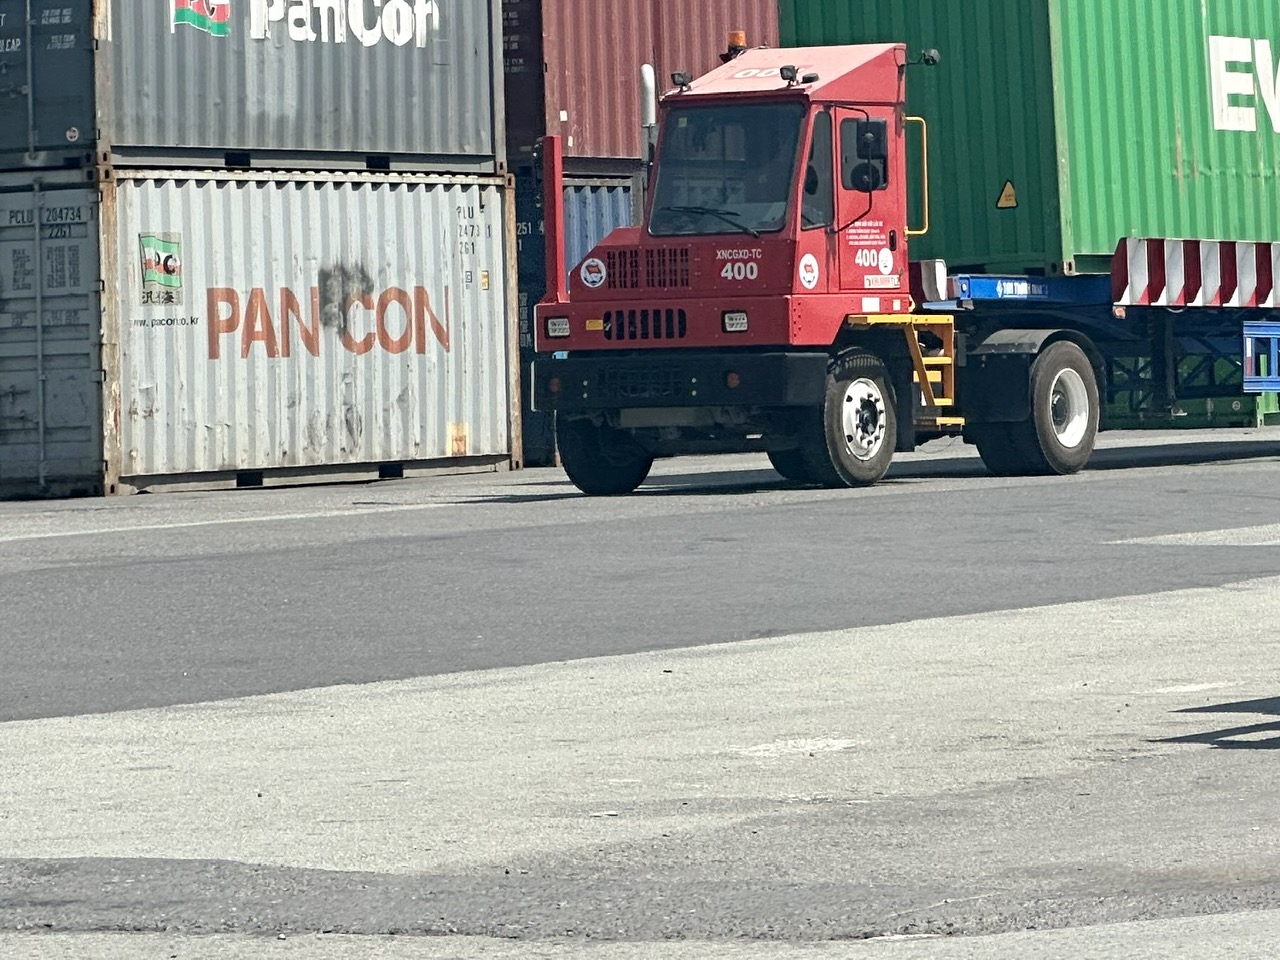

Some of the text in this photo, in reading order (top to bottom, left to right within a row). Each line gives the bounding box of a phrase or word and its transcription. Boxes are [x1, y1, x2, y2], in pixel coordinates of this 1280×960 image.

[9, 209, 34, 224] PCLU
[48, 224, 72, 239] 22G1
[855, 248, 878, 267] 400
[721, 262, 758, 280] 400
[207, 285, 449, 360] PAN CON
